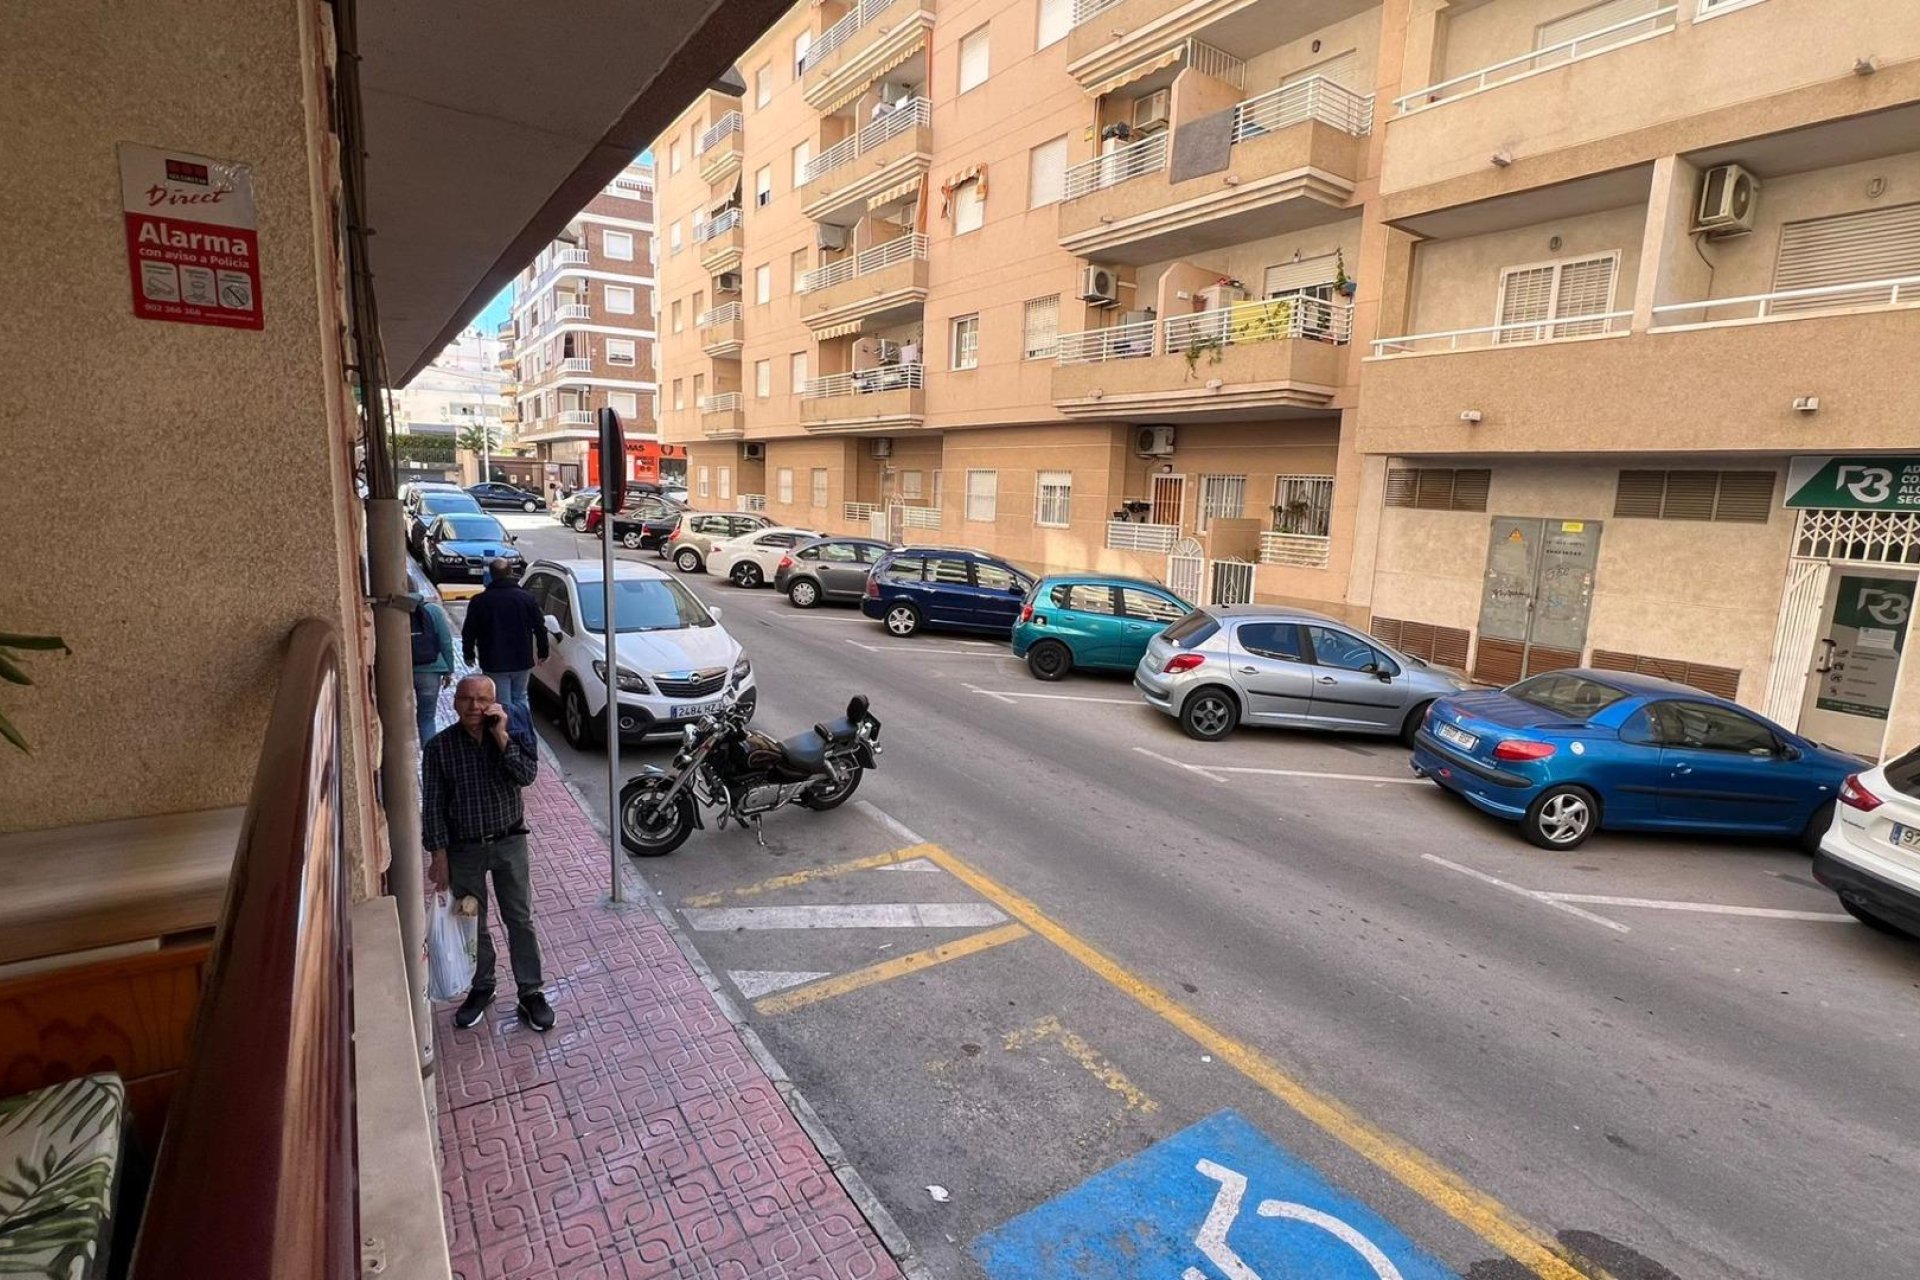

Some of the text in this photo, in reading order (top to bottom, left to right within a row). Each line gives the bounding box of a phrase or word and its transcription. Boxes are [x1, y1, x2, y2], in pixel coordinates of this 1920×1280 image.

[145, 184, 233, 206] Direct
[138, 222, 249, 257] Alarma
[139, 247, 162, 258] con
[165, 250, 197, 262] aviso
[200, 255, 208, 264] a
